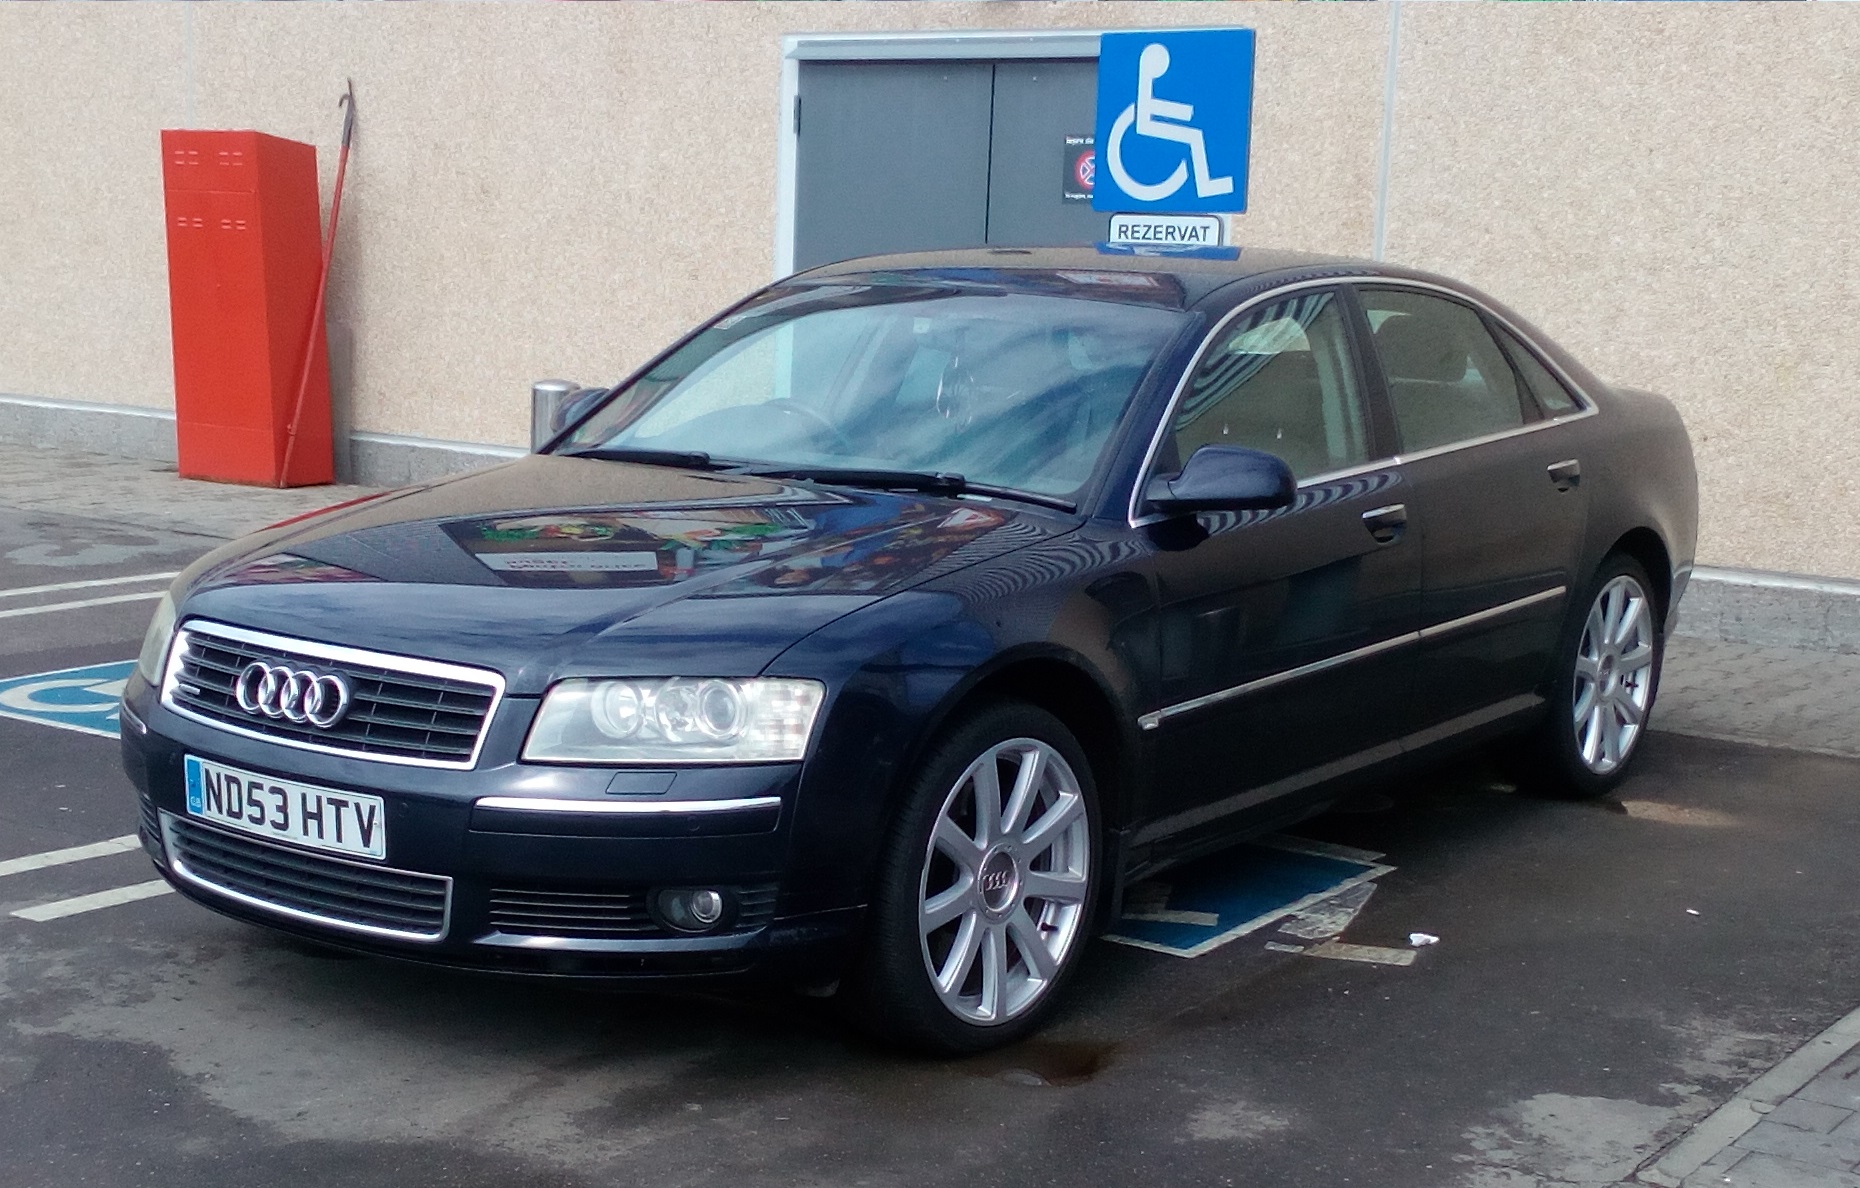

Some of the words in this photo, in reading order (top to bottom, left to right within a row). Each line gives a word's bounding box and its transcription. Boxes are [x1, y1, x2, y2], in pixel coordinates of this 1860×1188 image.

[1118, 224, 1210, 242] REZERVAT
[204, 768, 290, 832] ND53
[301, 792, 376, 848] HTV
